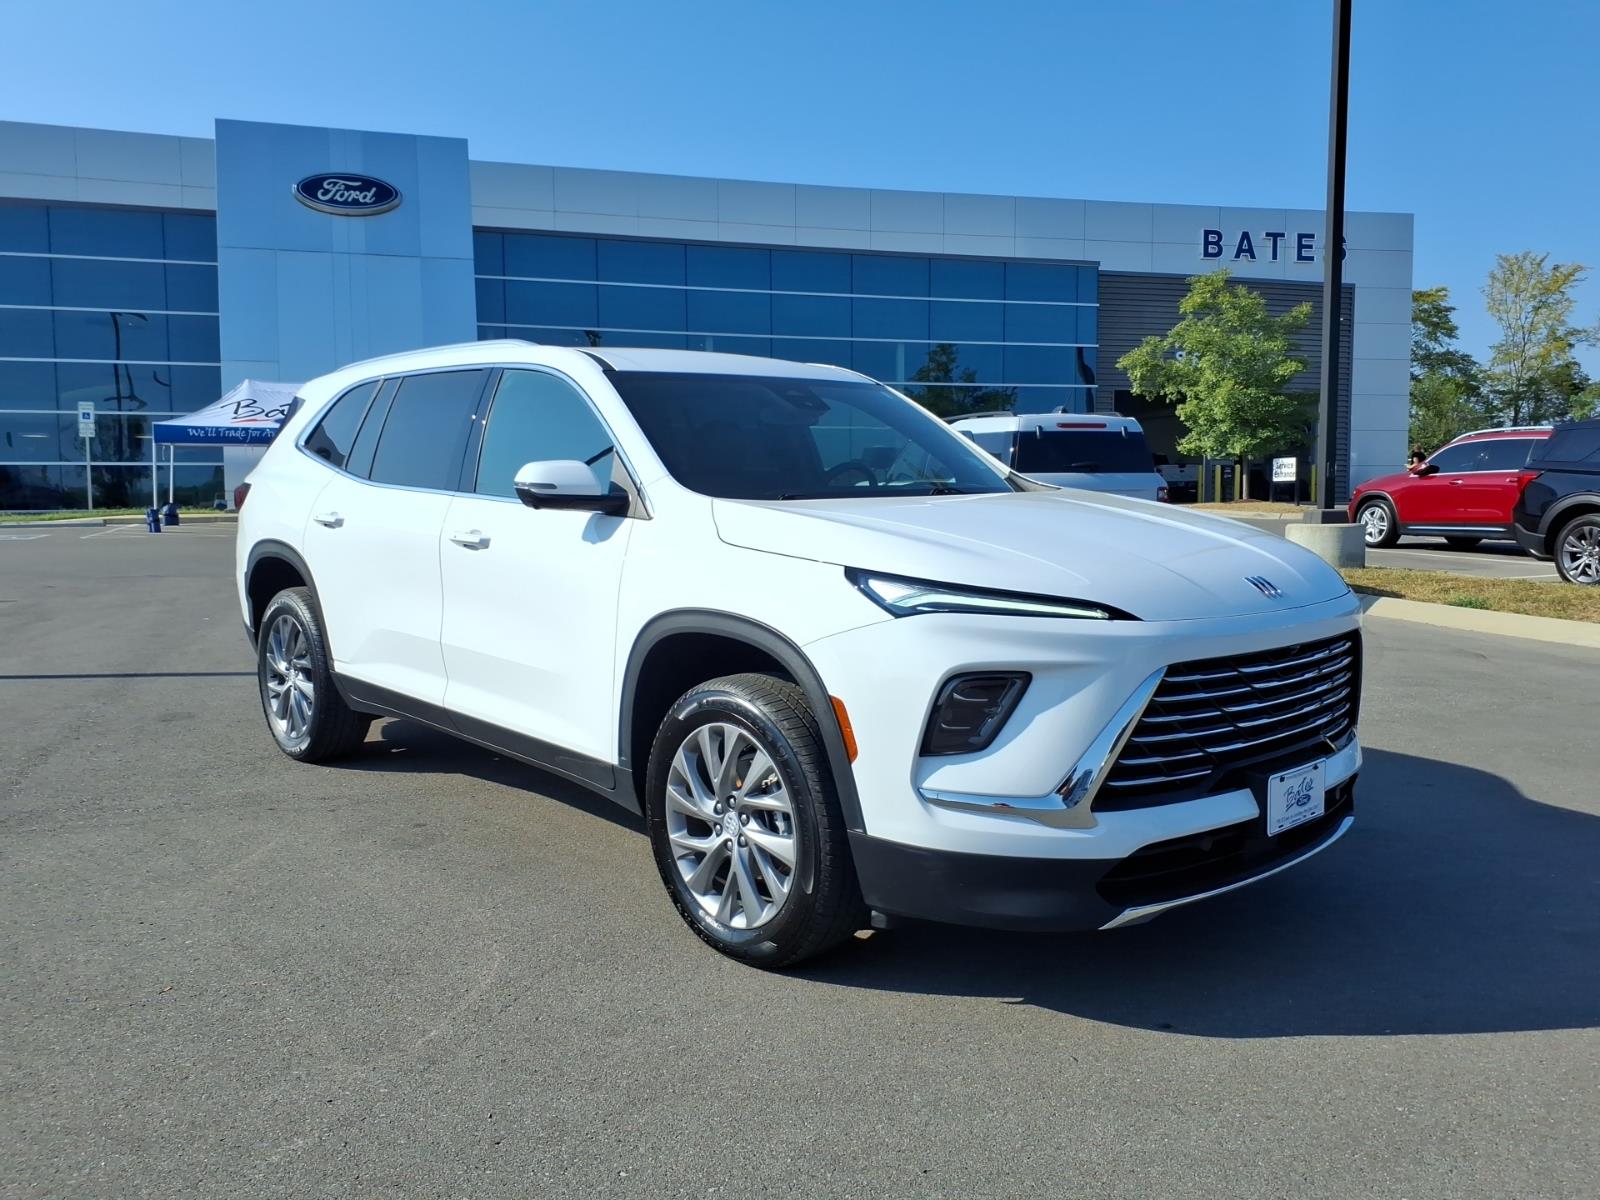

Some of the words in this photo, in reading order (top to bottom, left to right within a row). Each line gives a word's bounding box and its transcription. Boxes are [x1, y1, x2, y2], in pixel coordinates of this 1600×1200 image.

[317, 178, 377, 203] Ford
[1201, 228, 1347, 263] BATE
[187, 427, 217, 437] We'll
[218, 427, 246, 440] Trade
[246, 427, 262, 443] for
